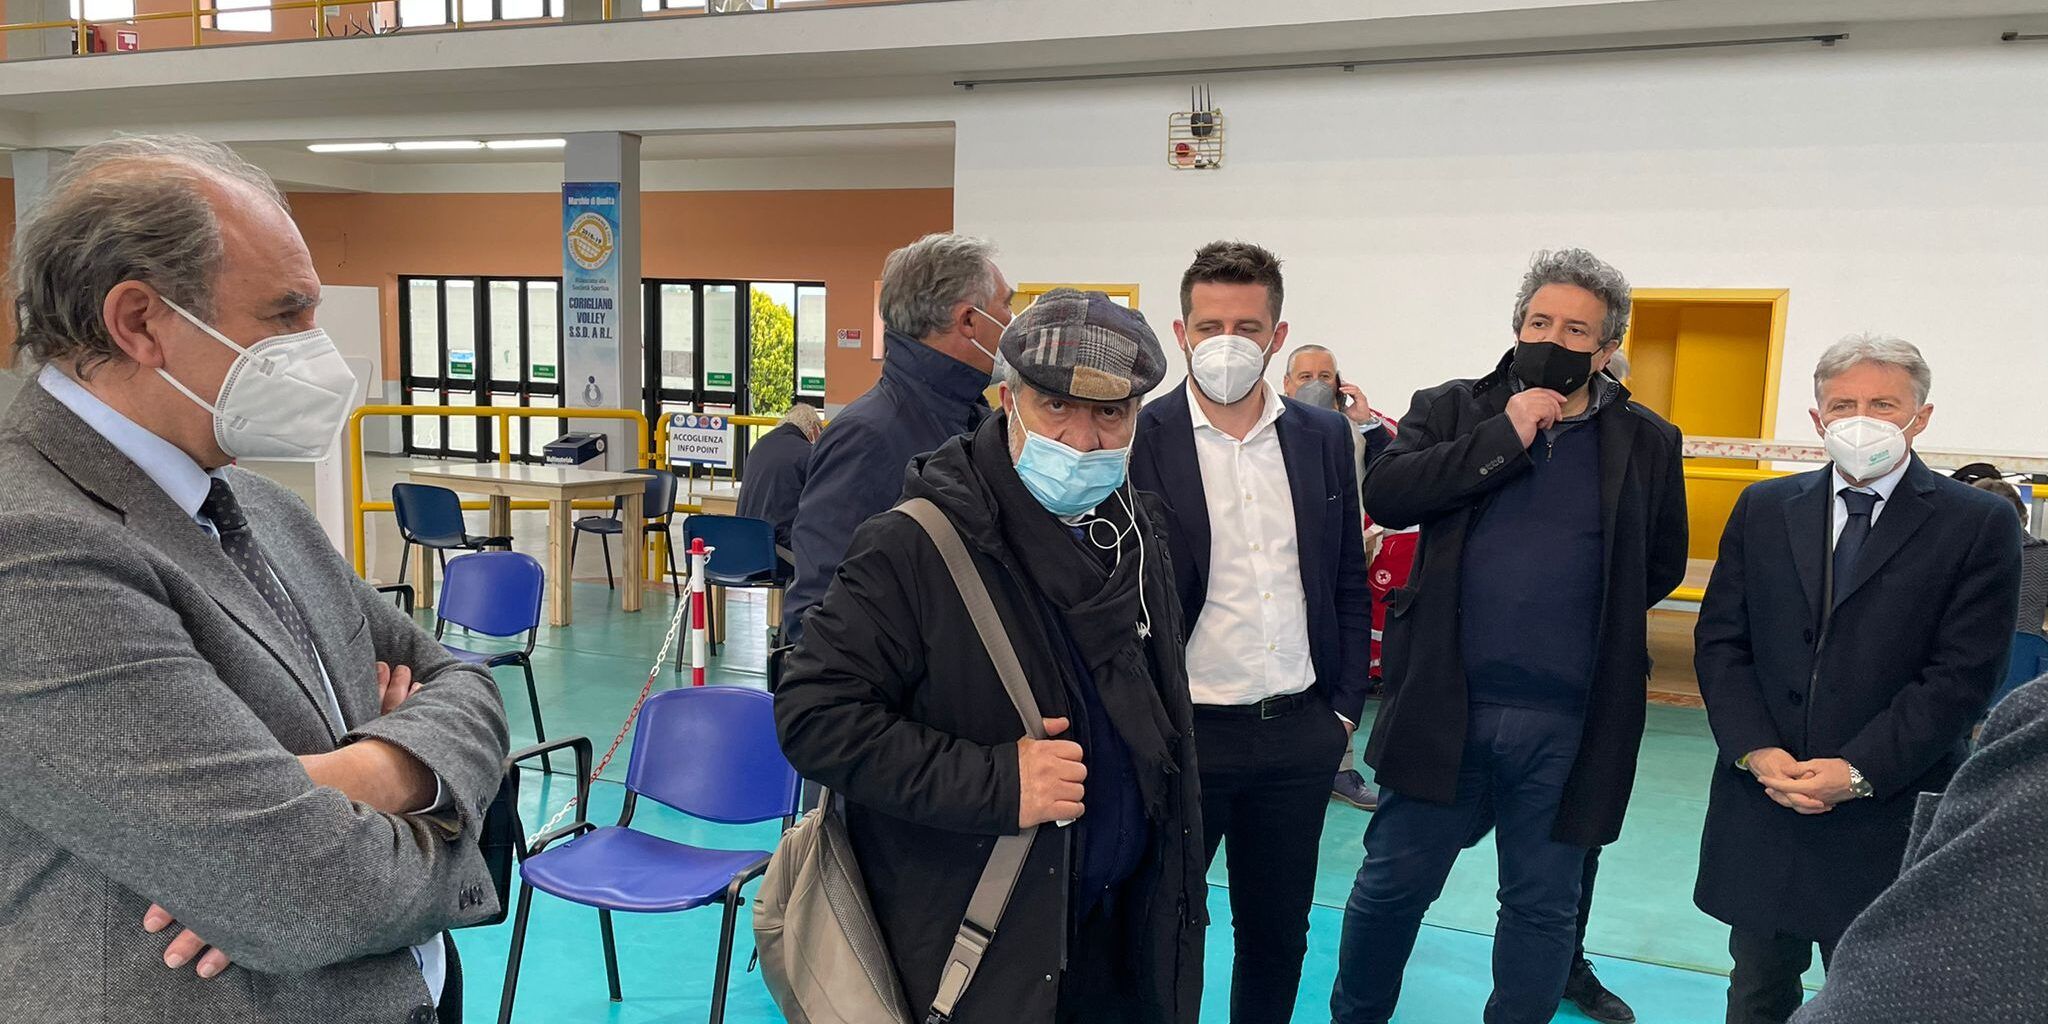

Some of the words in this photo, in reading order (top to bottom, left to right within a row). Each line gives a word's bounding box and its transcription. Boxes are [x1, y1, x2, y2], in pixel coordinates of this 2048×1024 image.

[569, 297, 613, 310] CORIGLIANO
[576, 311, 606, 325] VOLLEY
[569, 325, 590, 339] S.S.D.
[592, 327, 598, 339] A
[673, 433, 723, 444] ACCOGLIENZA
[677, 444, 696, 453] INFO
[696, 445, 719, 455] POINT
